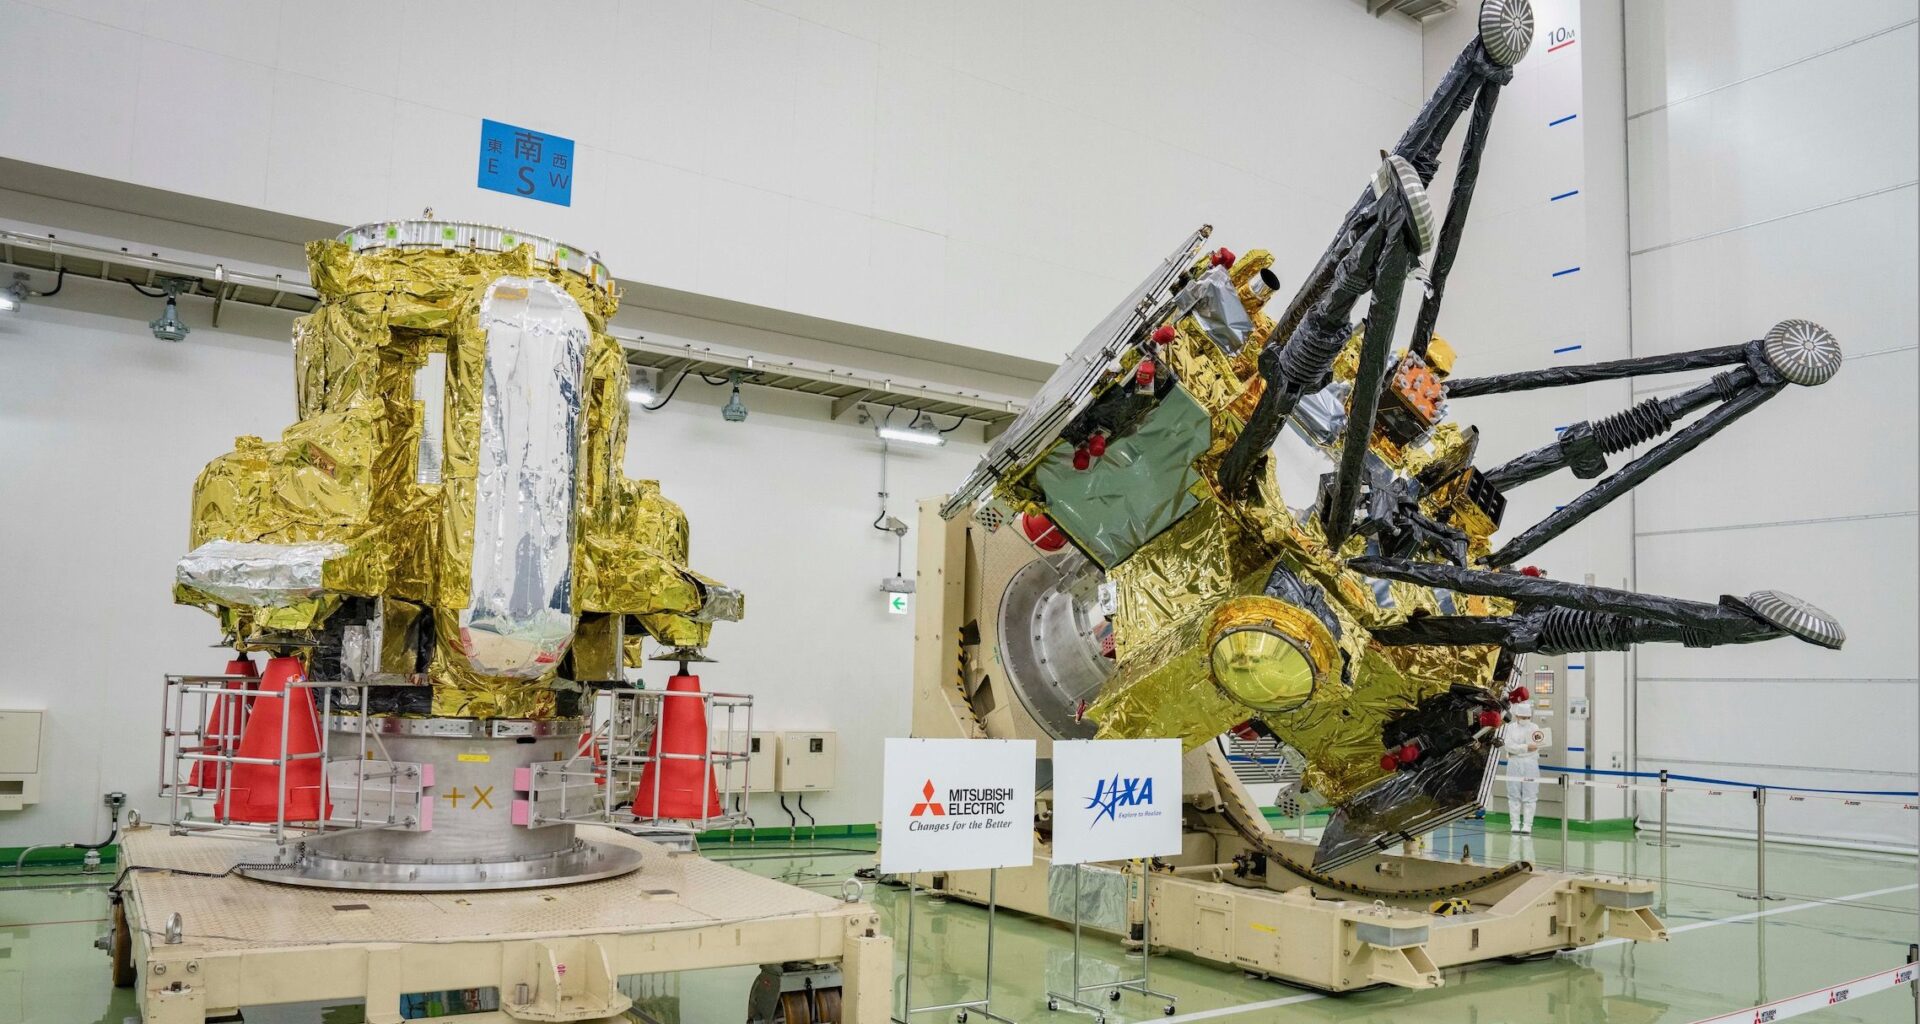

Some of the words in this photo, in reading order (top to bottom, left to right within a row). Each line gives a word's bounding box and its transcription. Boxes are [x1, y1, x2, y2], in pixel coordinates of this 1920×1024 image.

[487, 138, 503, 154] 東
[515, 131, 544, 164] 南
[552, 152, 568, 170] 西
[488, 158, 499, 175] E
[517, 166, 535, 195] S
[549, 171, 569, 190] W
[949, 788, 1014, 802] MITSUBISHI
[1082, 773, 1153, 822] JAXA
[949, 802, 1005, 815] ELECTRIC
[909, 820, 950, 832] Changes
[951, 820, 967, 831] for
[969, 819, 983, 830] the
[985, 818, 1013, 829] Better
